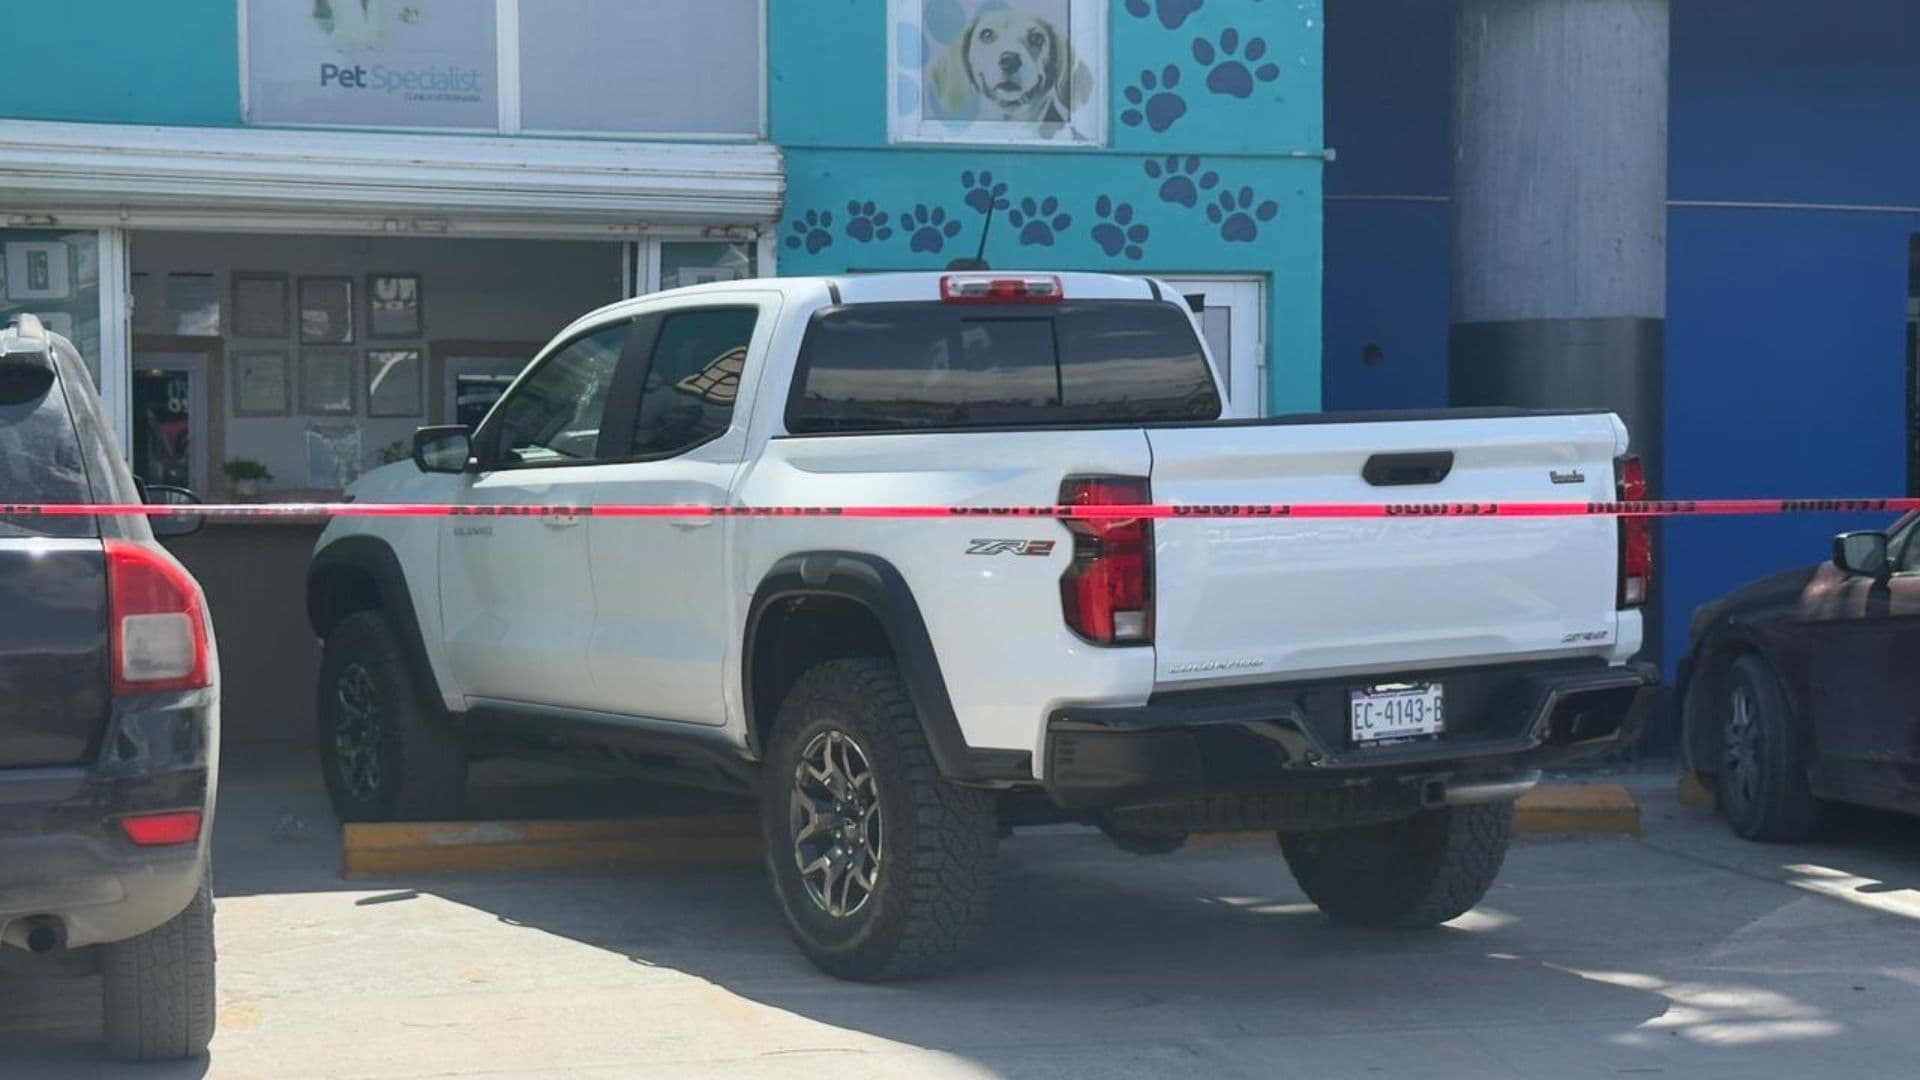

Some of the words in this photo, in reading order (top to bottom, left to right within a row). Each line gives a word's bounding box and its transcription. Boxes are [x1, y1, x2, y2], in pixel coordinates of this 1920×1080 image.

[320, 63, 367, 88] Pet
[371, 64, 481, 93] Specialist
[965, 538, 1055, 556] ZR2
